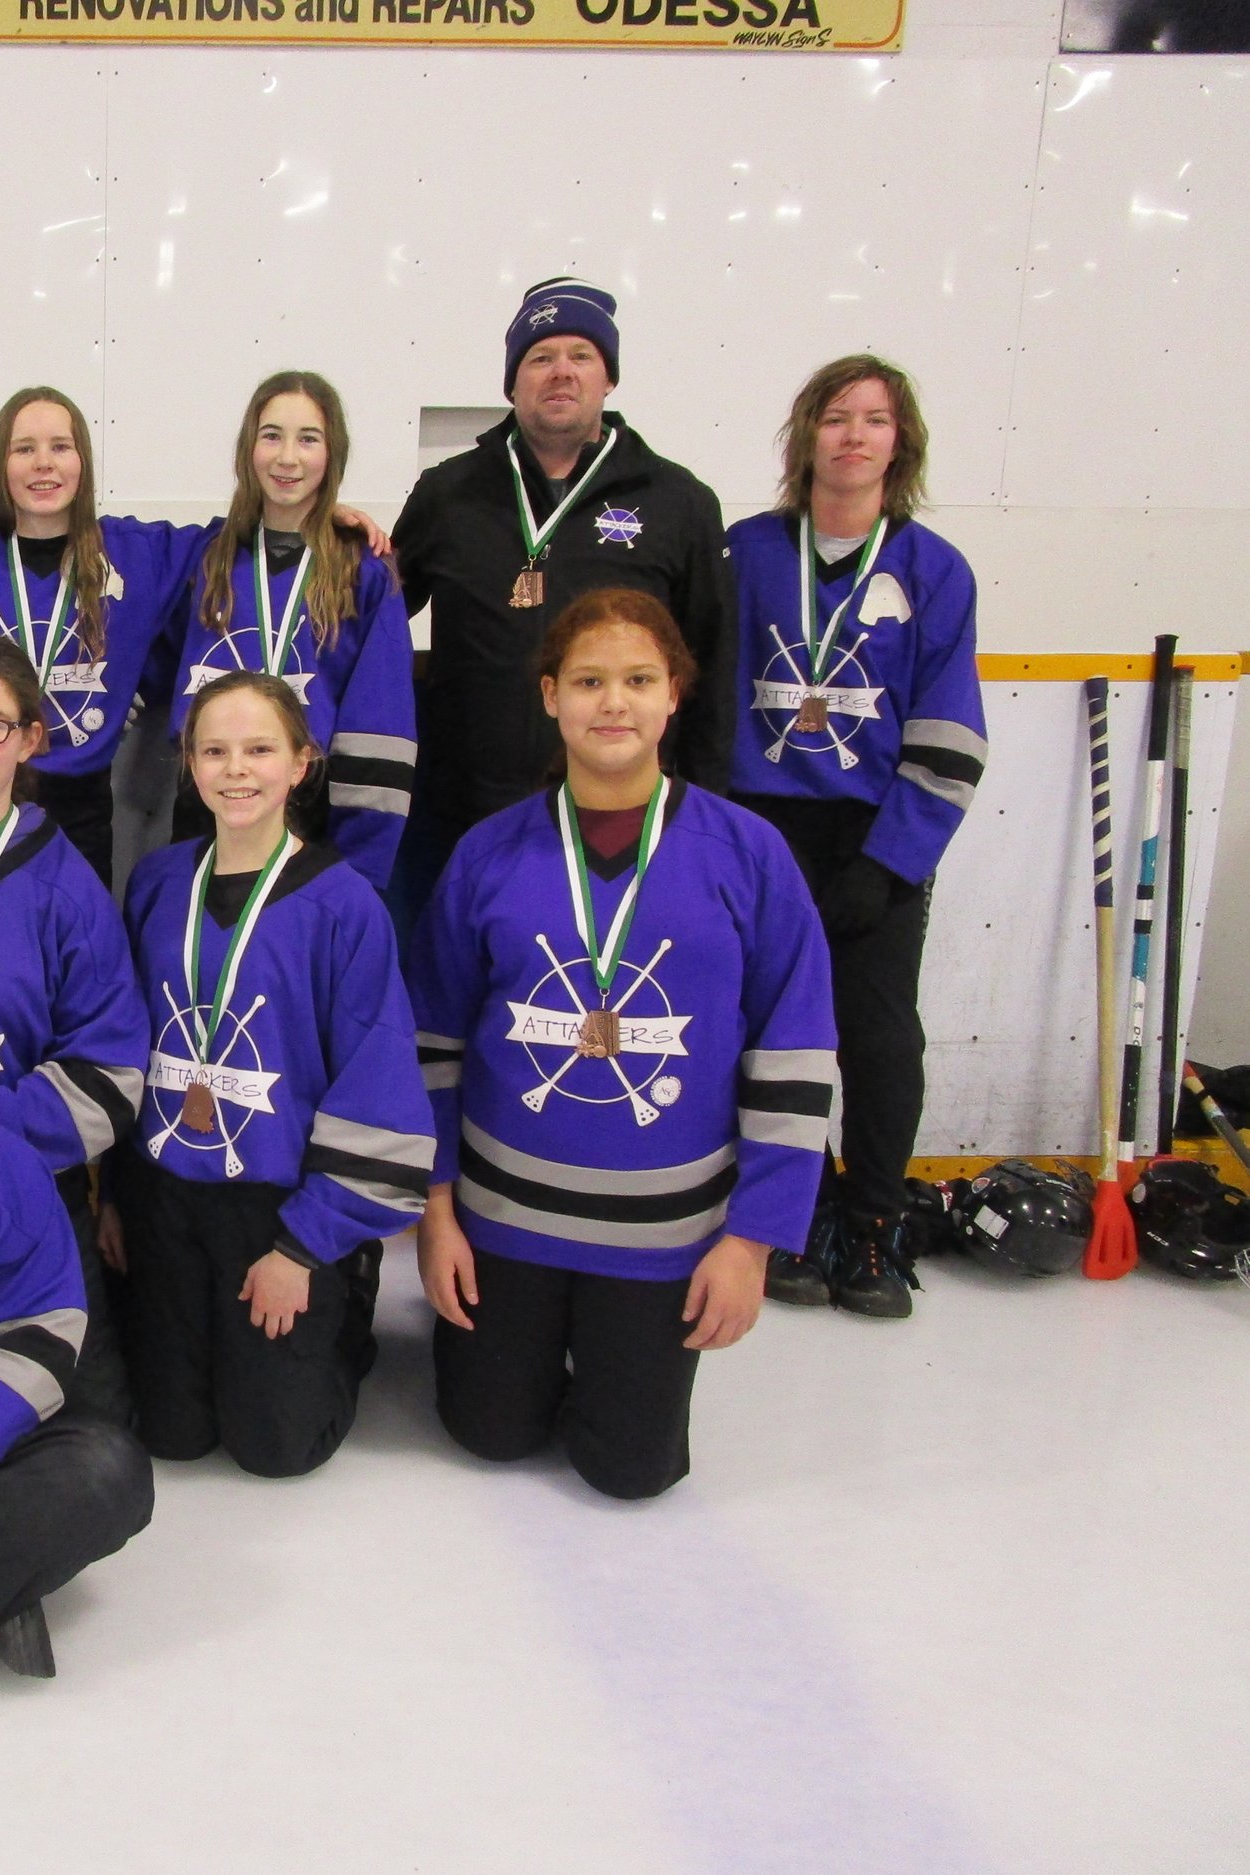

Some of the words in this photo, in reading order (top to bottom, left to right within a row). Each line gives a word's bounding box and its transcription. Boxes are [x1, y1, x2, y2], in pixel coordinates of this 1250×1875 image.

[19, 0, 285, 21] RENOVATIONS
[295, 0, 359, 22] and
[372, 0, 535, 26] REPAIRS
[576, 0, 821, 28] ODESSA
[522, 1016, 674, 1044] ATTAERS
[155, 1062, 261, 1097] ATTACKERS
